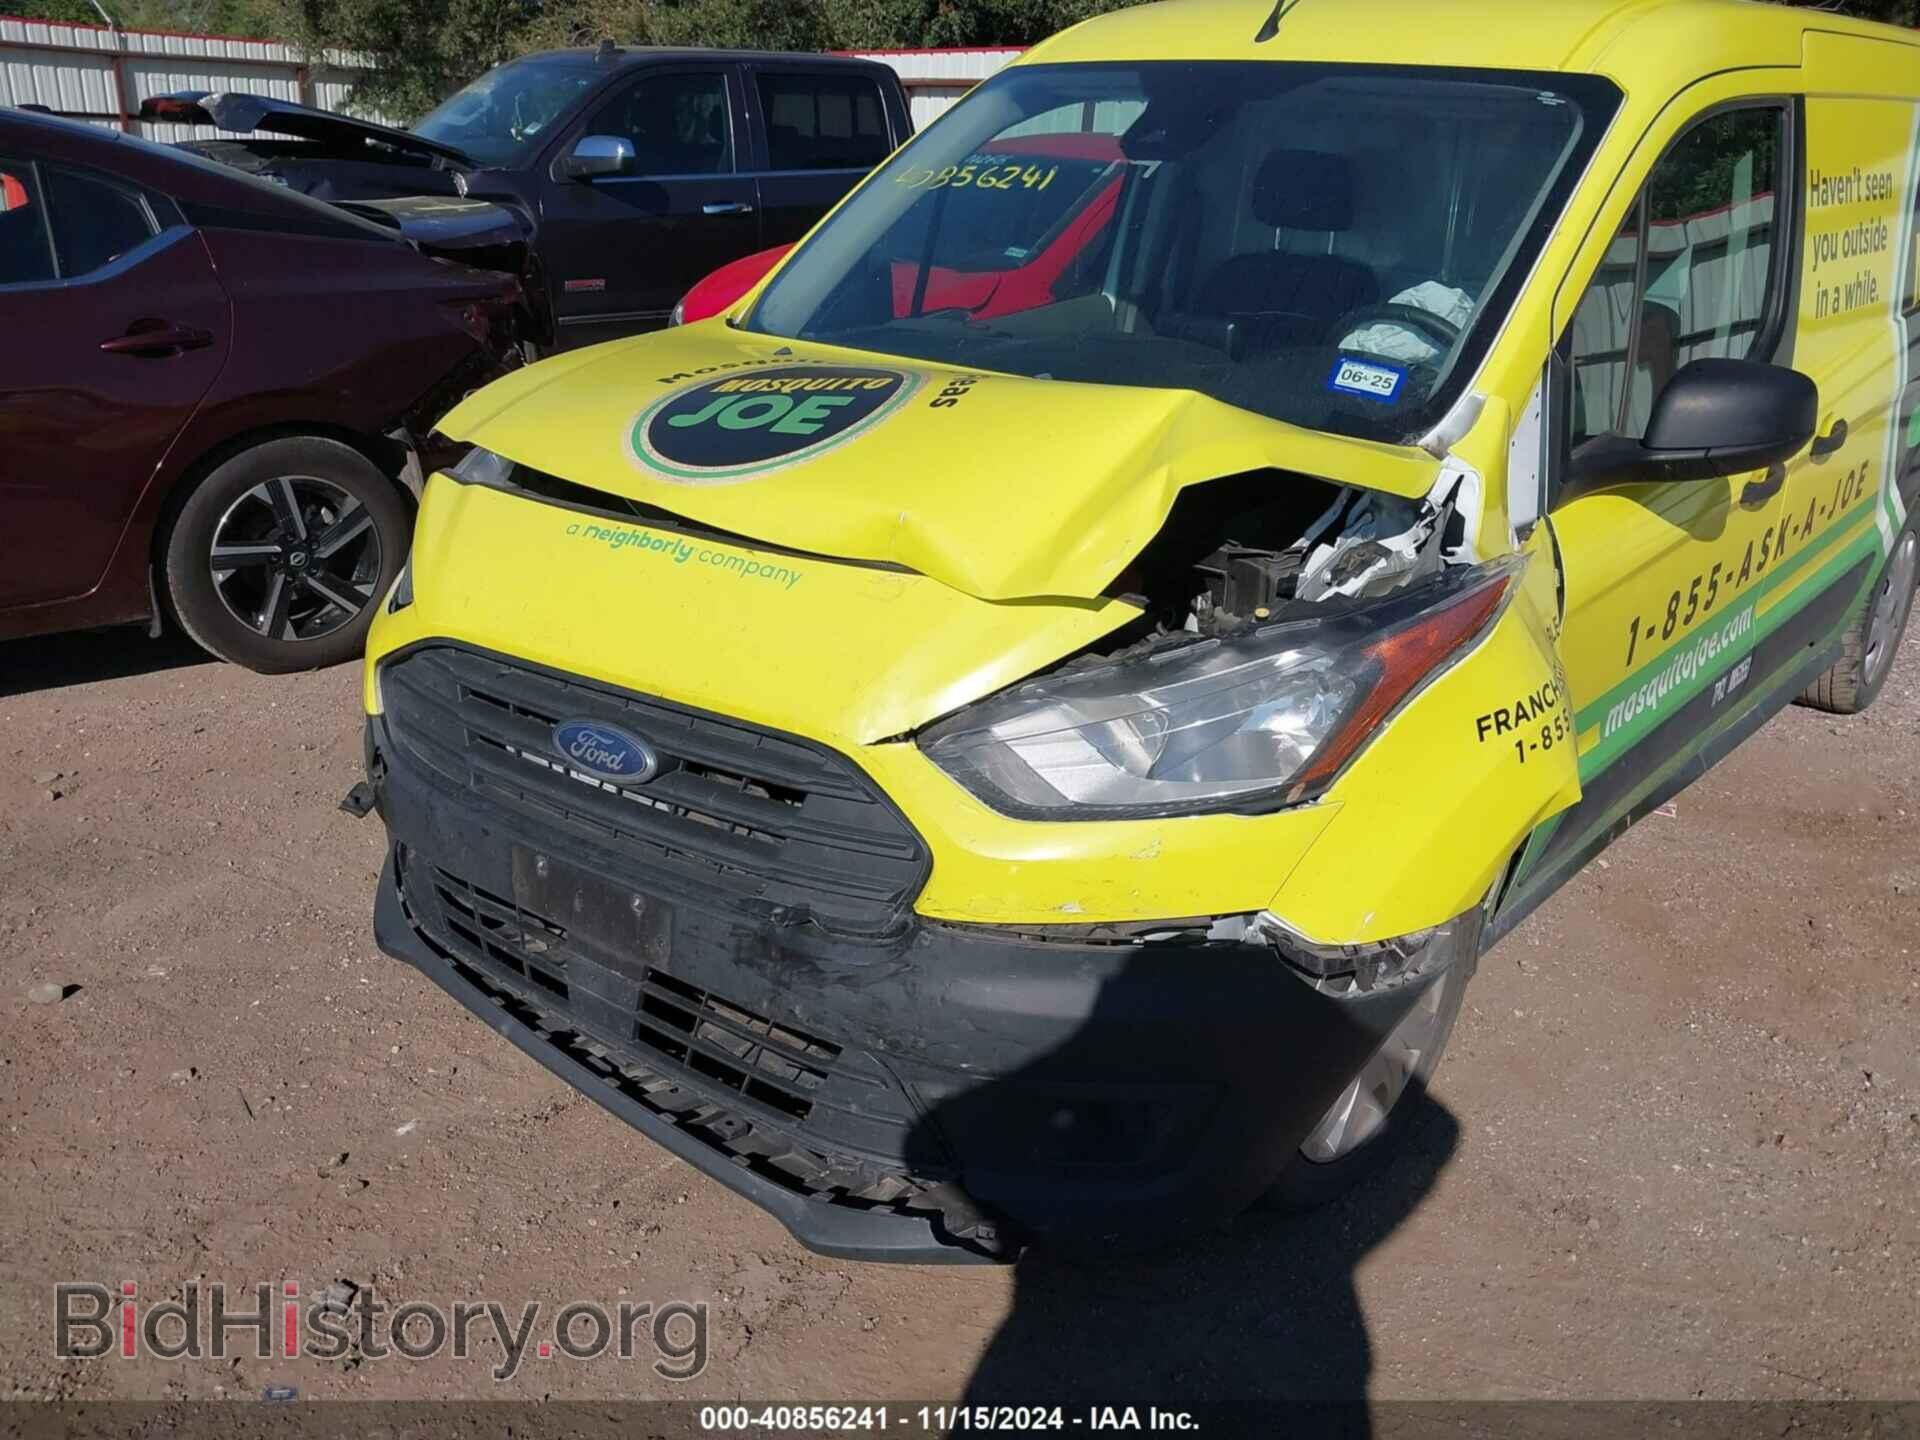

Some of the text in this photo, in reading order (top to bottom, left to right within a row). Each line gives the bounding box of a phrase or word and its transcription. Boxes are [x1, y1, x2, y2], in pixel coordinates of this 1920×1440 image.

[1810, 167, 1893, 207] Haven't seen
[1812, 216, 1888, 272] you outside
[1815, 270, 1880, 319] in a while.
[708, 377, 895, 394] MOSQUITO
[1340, 369, 1394, 389] 06 25
[667, 395, 856, 435] JOE
[566, 522, 803, 590] a neighborly company
[1604, 605, 1754, 738] mosquitojoe.com
[570, 730, 627, 771] Ford
